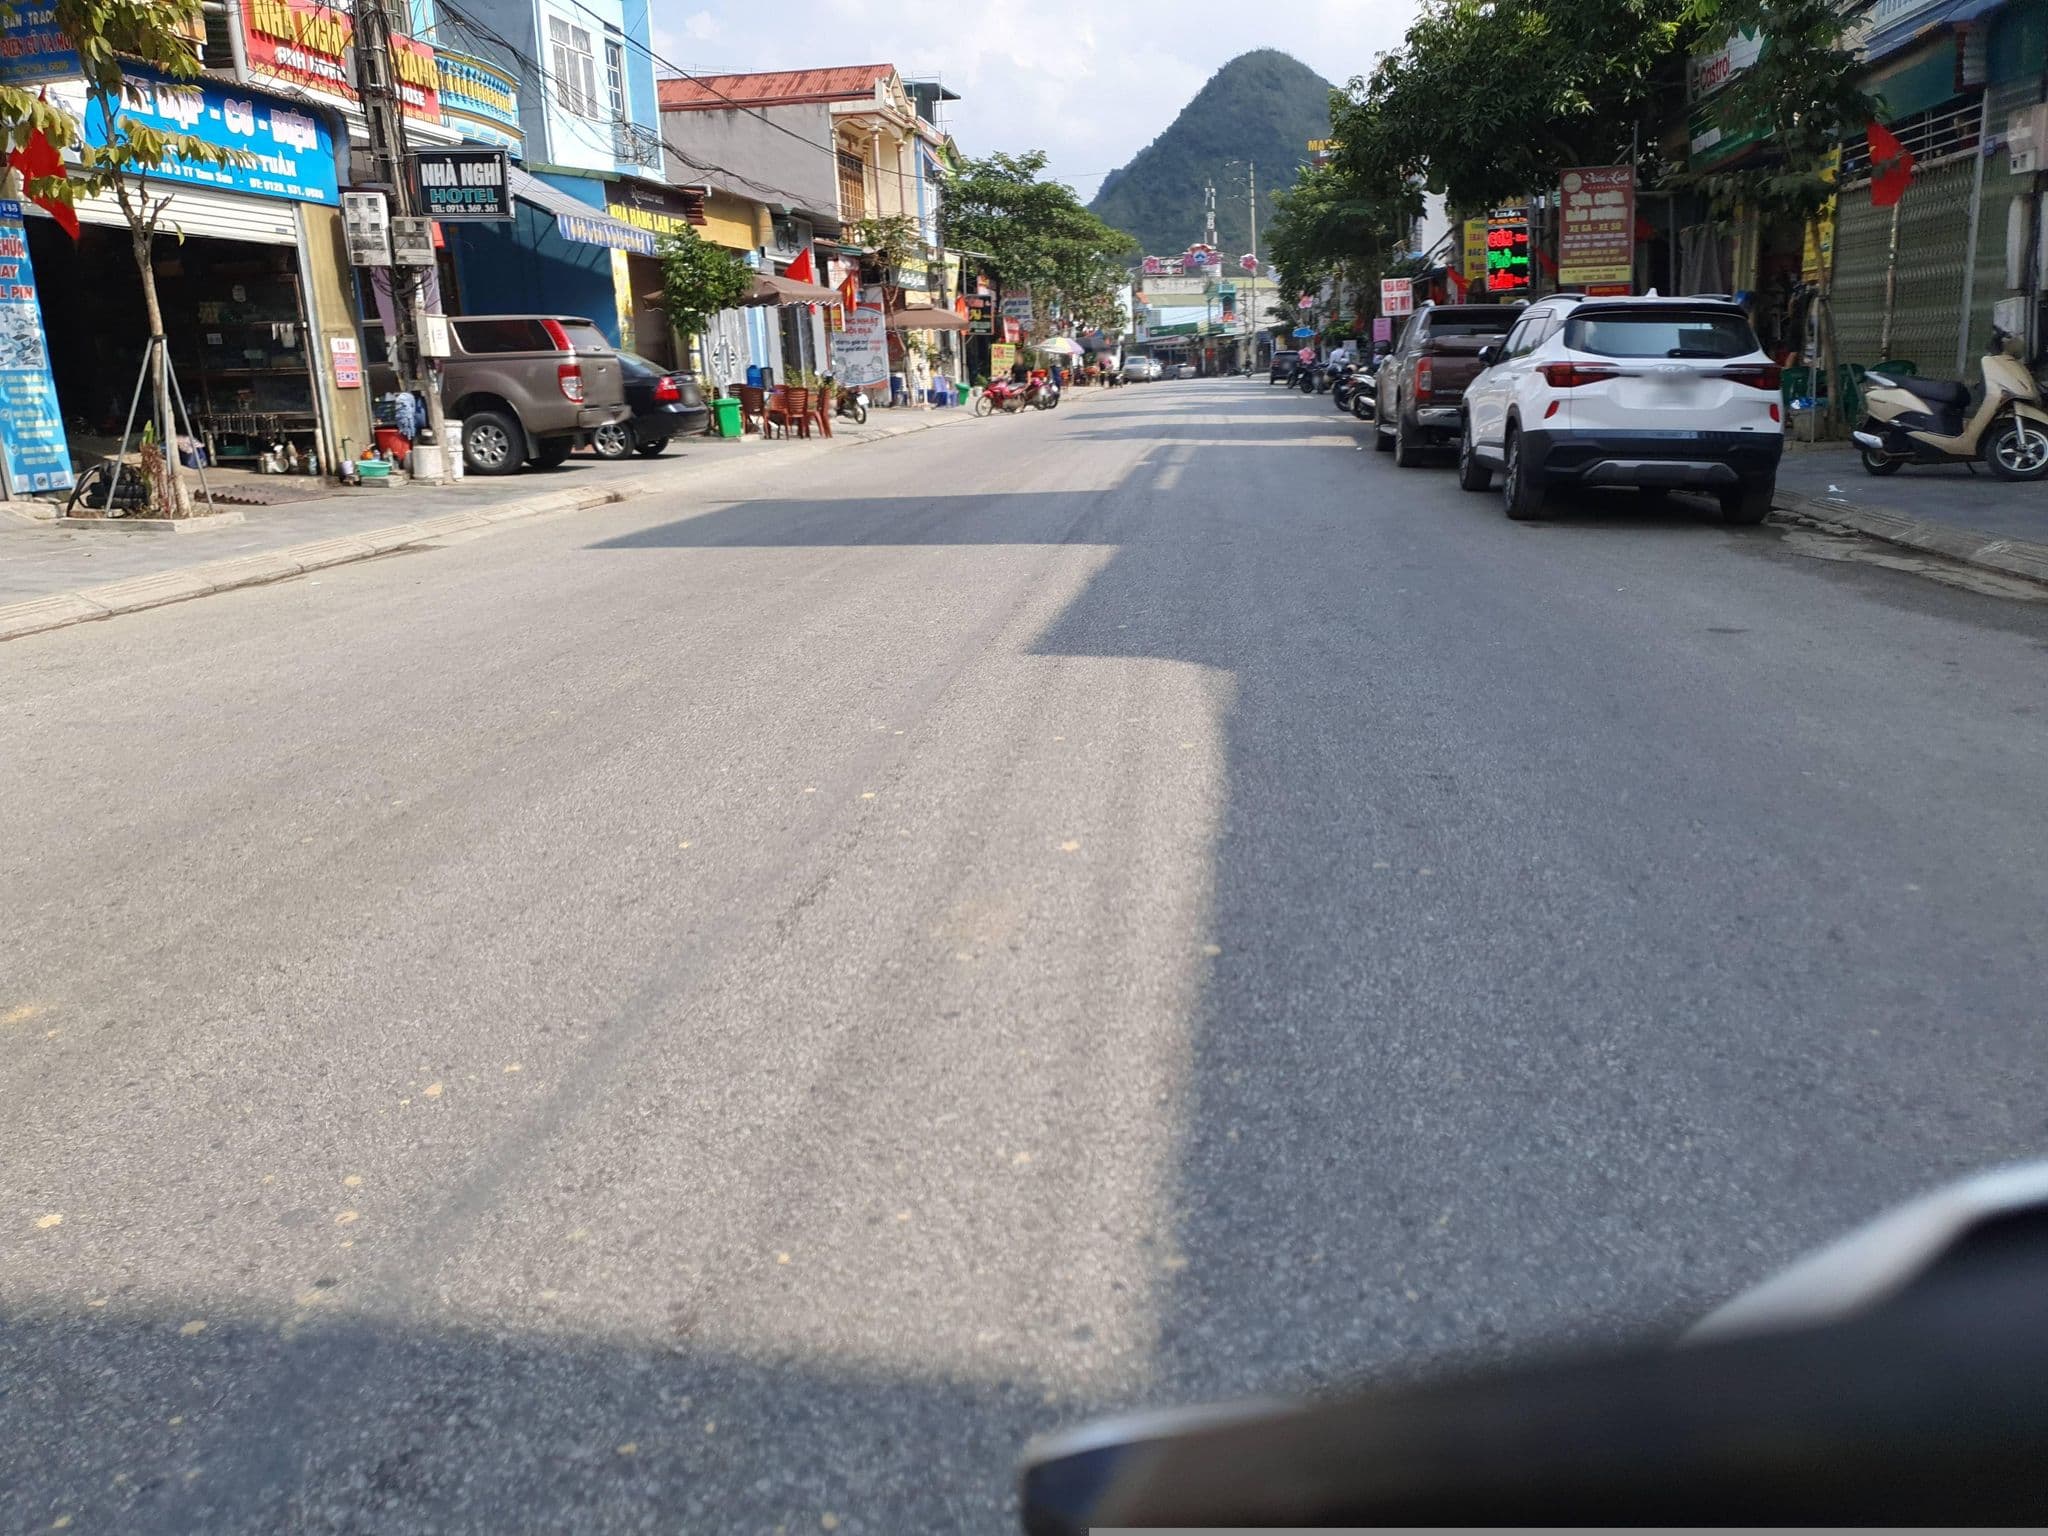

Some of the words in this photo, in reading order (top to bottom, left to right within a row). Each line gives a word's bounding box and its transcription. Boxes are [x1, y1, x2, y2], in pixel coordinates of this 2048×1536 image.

[420, 157, 458, 187] NHÀ
[460, 154, 502, 187] NGHỈ
[429, 187, 499, 204] HOTEL
[430, 204, 446, 213] TEL:
[445, 204, 467, 213] 0913.
[484, 204, 498, 213] 361
[10, 285, 34, 301] PIN
